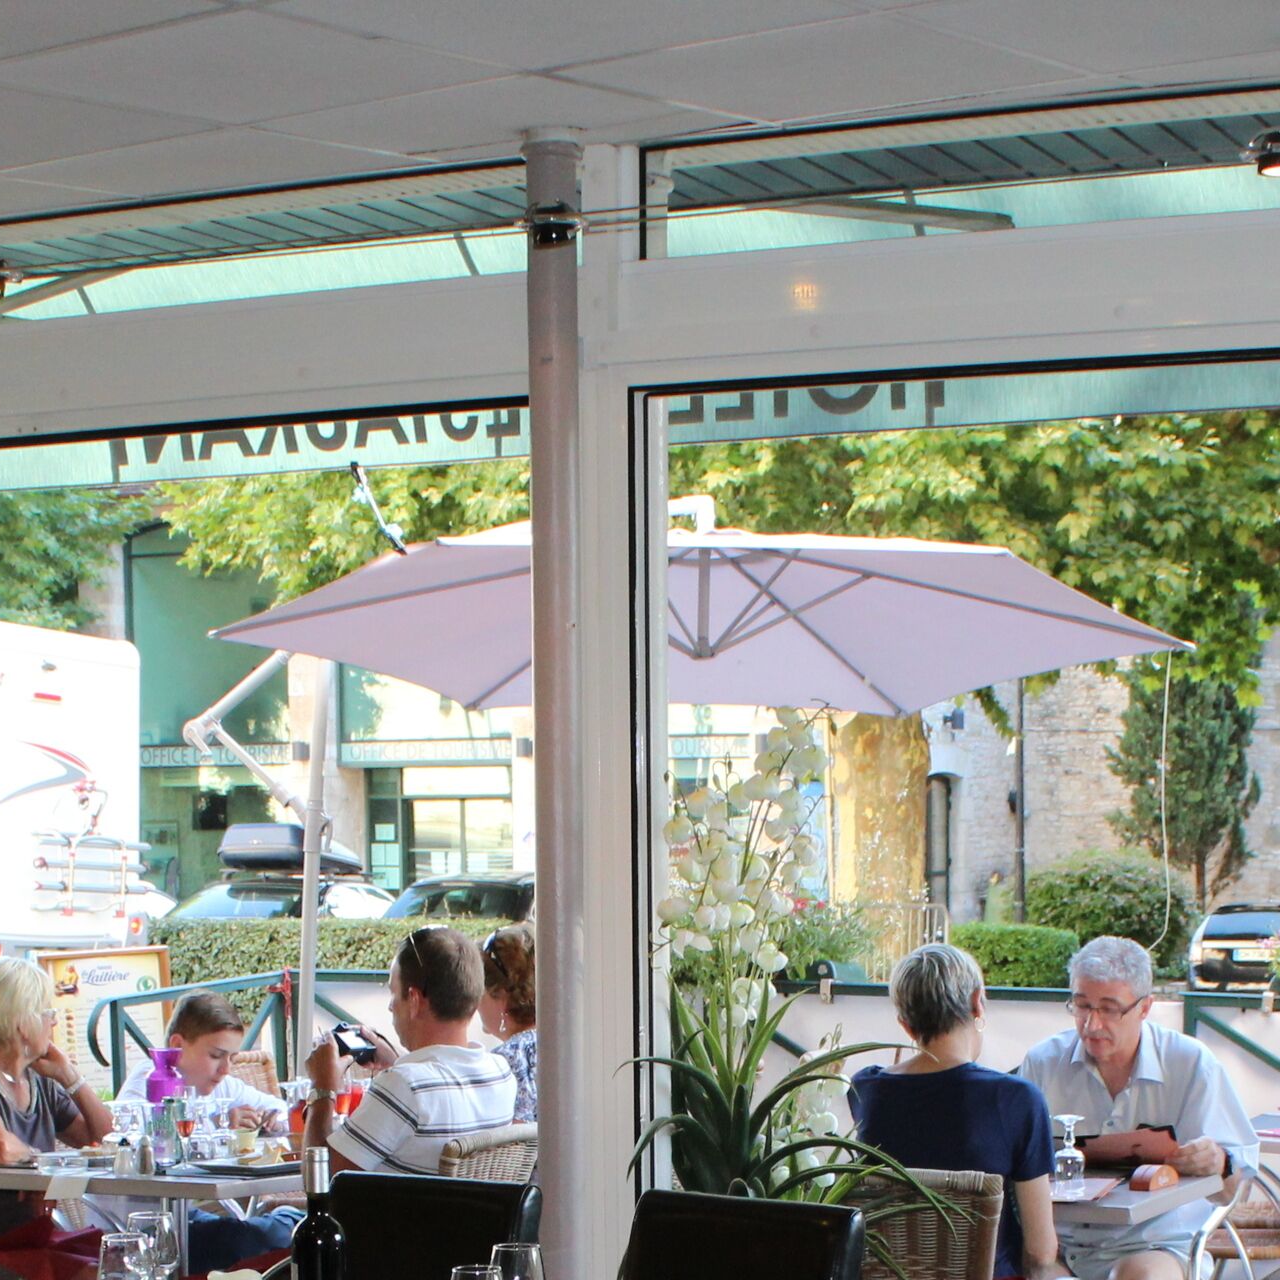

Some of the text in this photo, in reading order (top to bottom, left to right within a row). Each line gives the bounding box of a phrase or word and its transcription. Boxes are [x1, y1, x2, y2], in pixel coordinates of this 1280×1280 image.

[140, 748, 189, 765] OFFICE
[350, 744, 401, 760] OFFICE
[407, 743, 426, 759] DE
